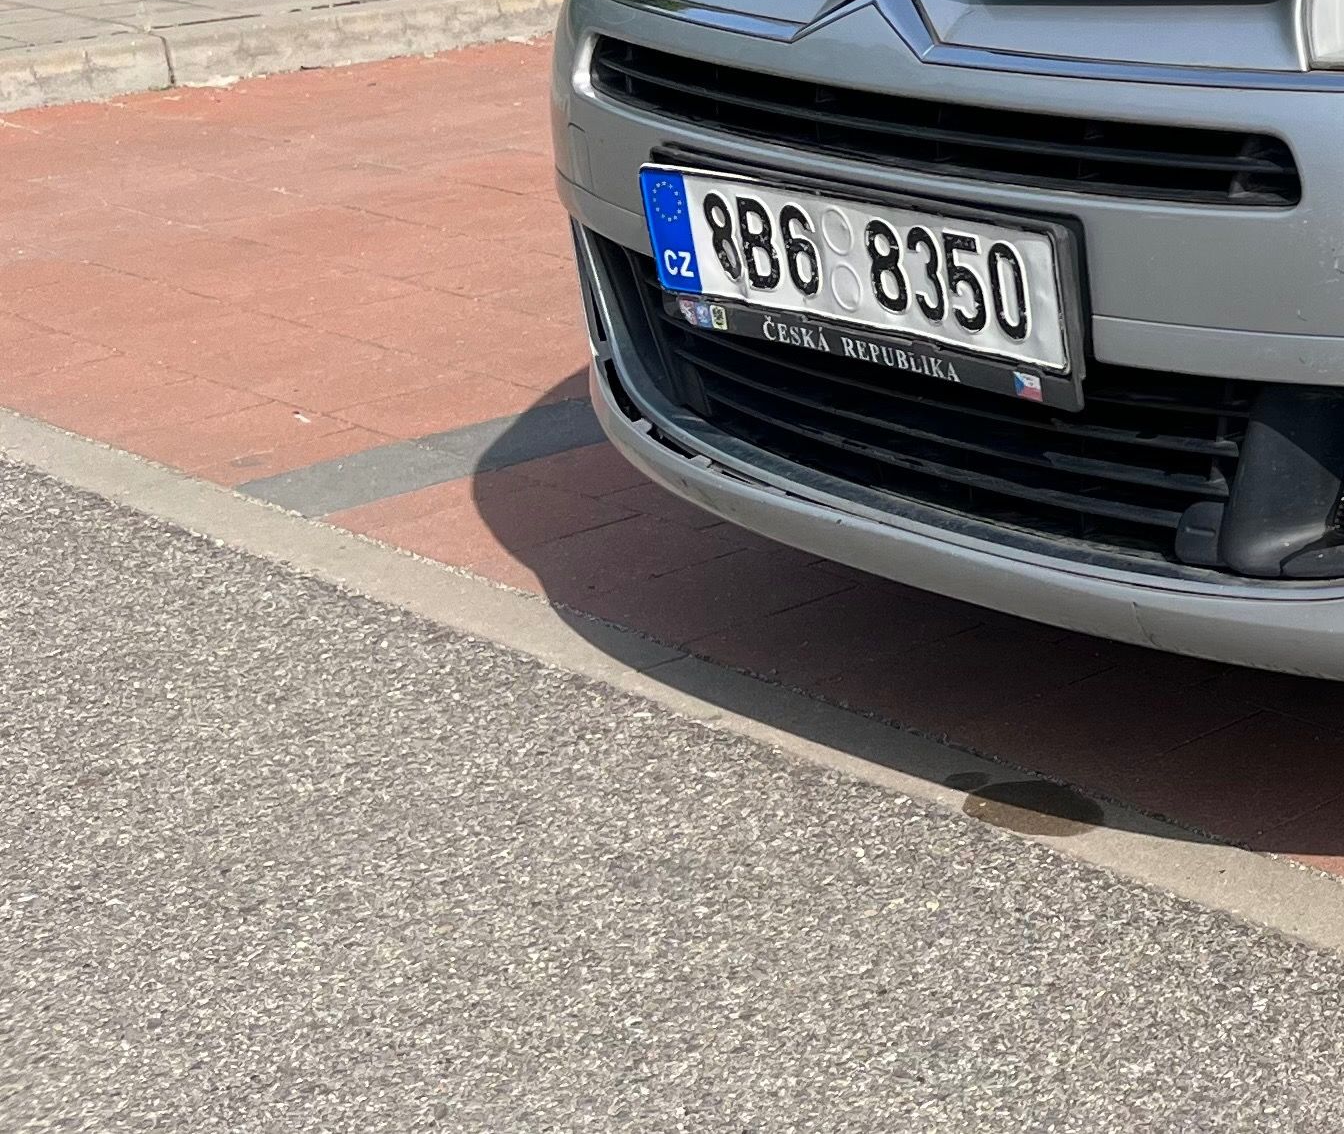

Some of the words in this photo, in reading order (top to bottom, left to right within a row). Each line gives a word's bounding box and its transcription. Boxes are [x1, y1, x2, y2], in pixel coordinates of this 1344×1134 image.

[663, 249, 695, 278] CZ
[703, 190, 821, 296] 8B6
[864, 217, 1032, 341] 8350
[762, 315, 831, 353] ČESKÁ
[840, 336, 961, 383] REPUBLIKA
